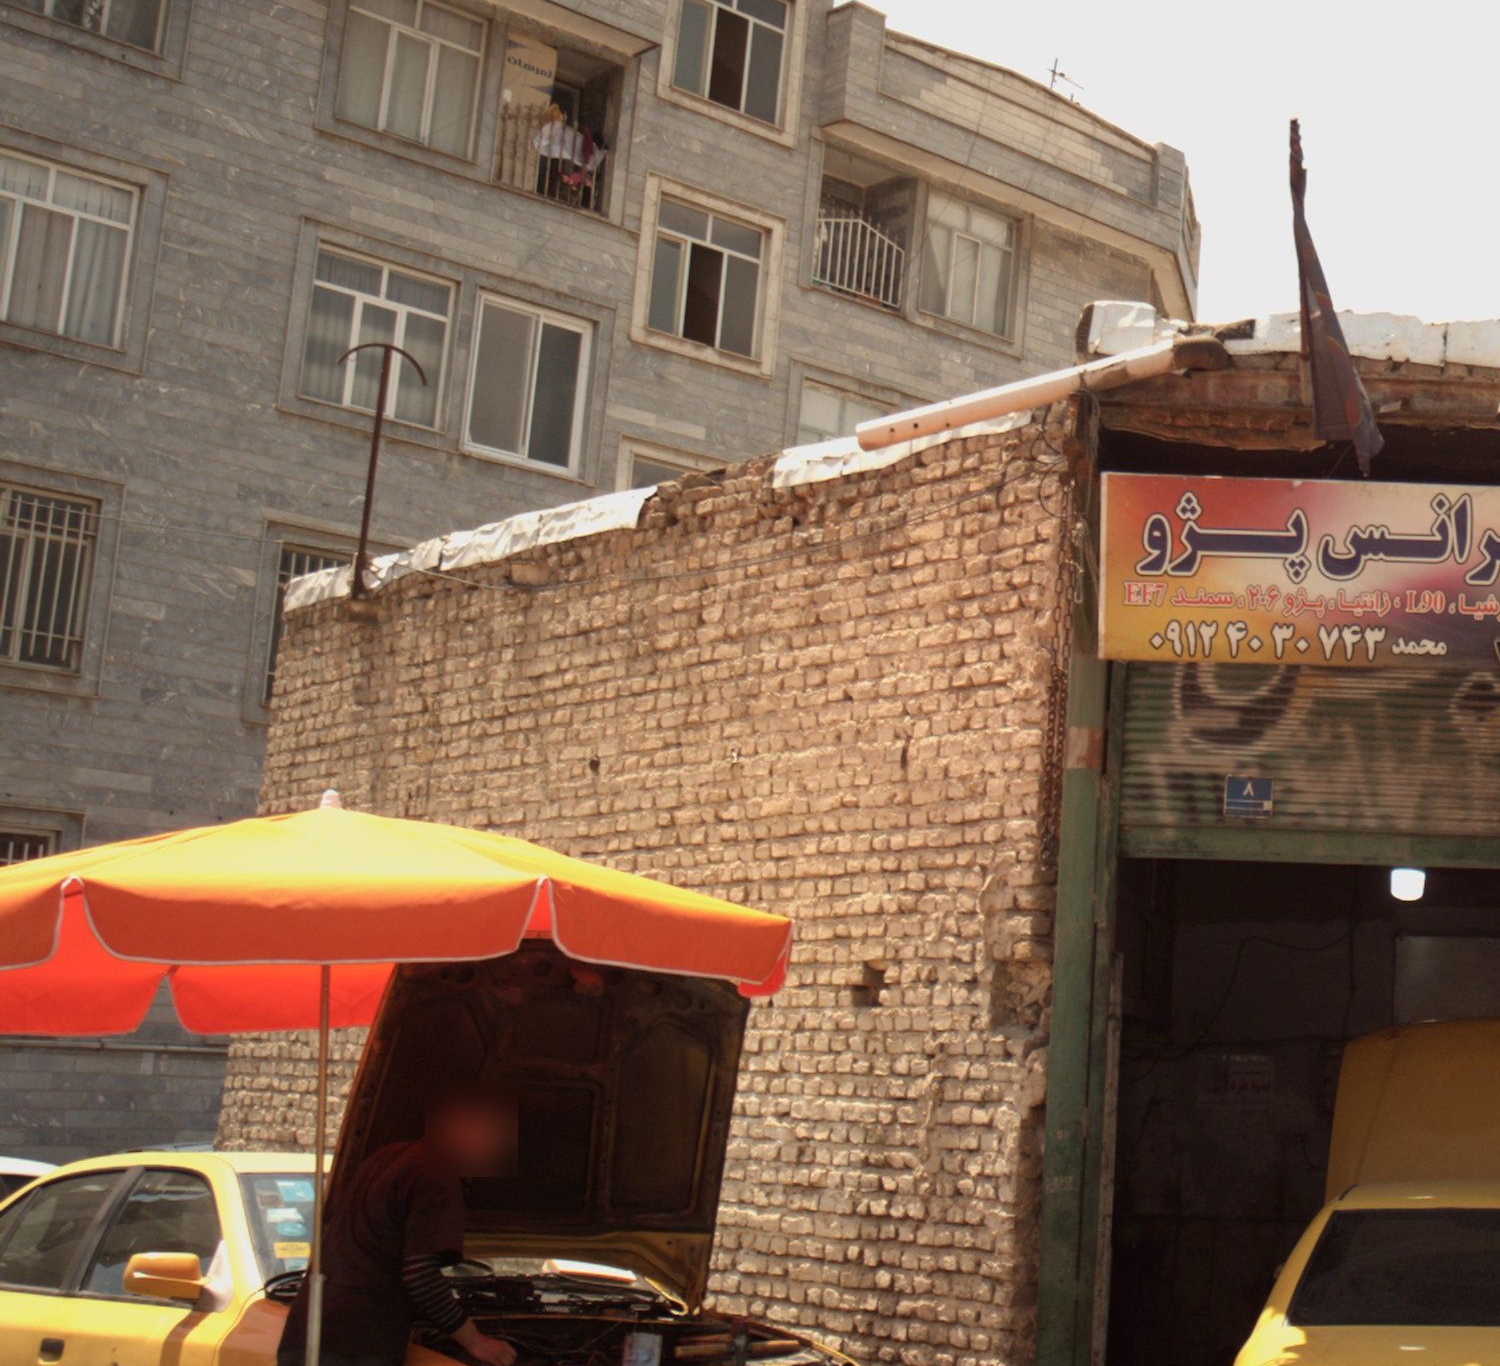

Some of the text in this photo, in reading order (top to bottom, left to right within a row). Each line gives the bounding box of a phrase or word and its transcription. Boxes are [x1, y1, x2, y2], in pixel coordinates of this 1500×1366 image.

[1135, 491, 1312, 584] پژو
[1123, 580, 1167, 606] EF7
[1170, 586, 1235, 608] سمند
[1283, 587, 1325, 619] پژو
[1391, 635, 1448, 657] محمد
[1243, 781, 1255, 796] ۸
